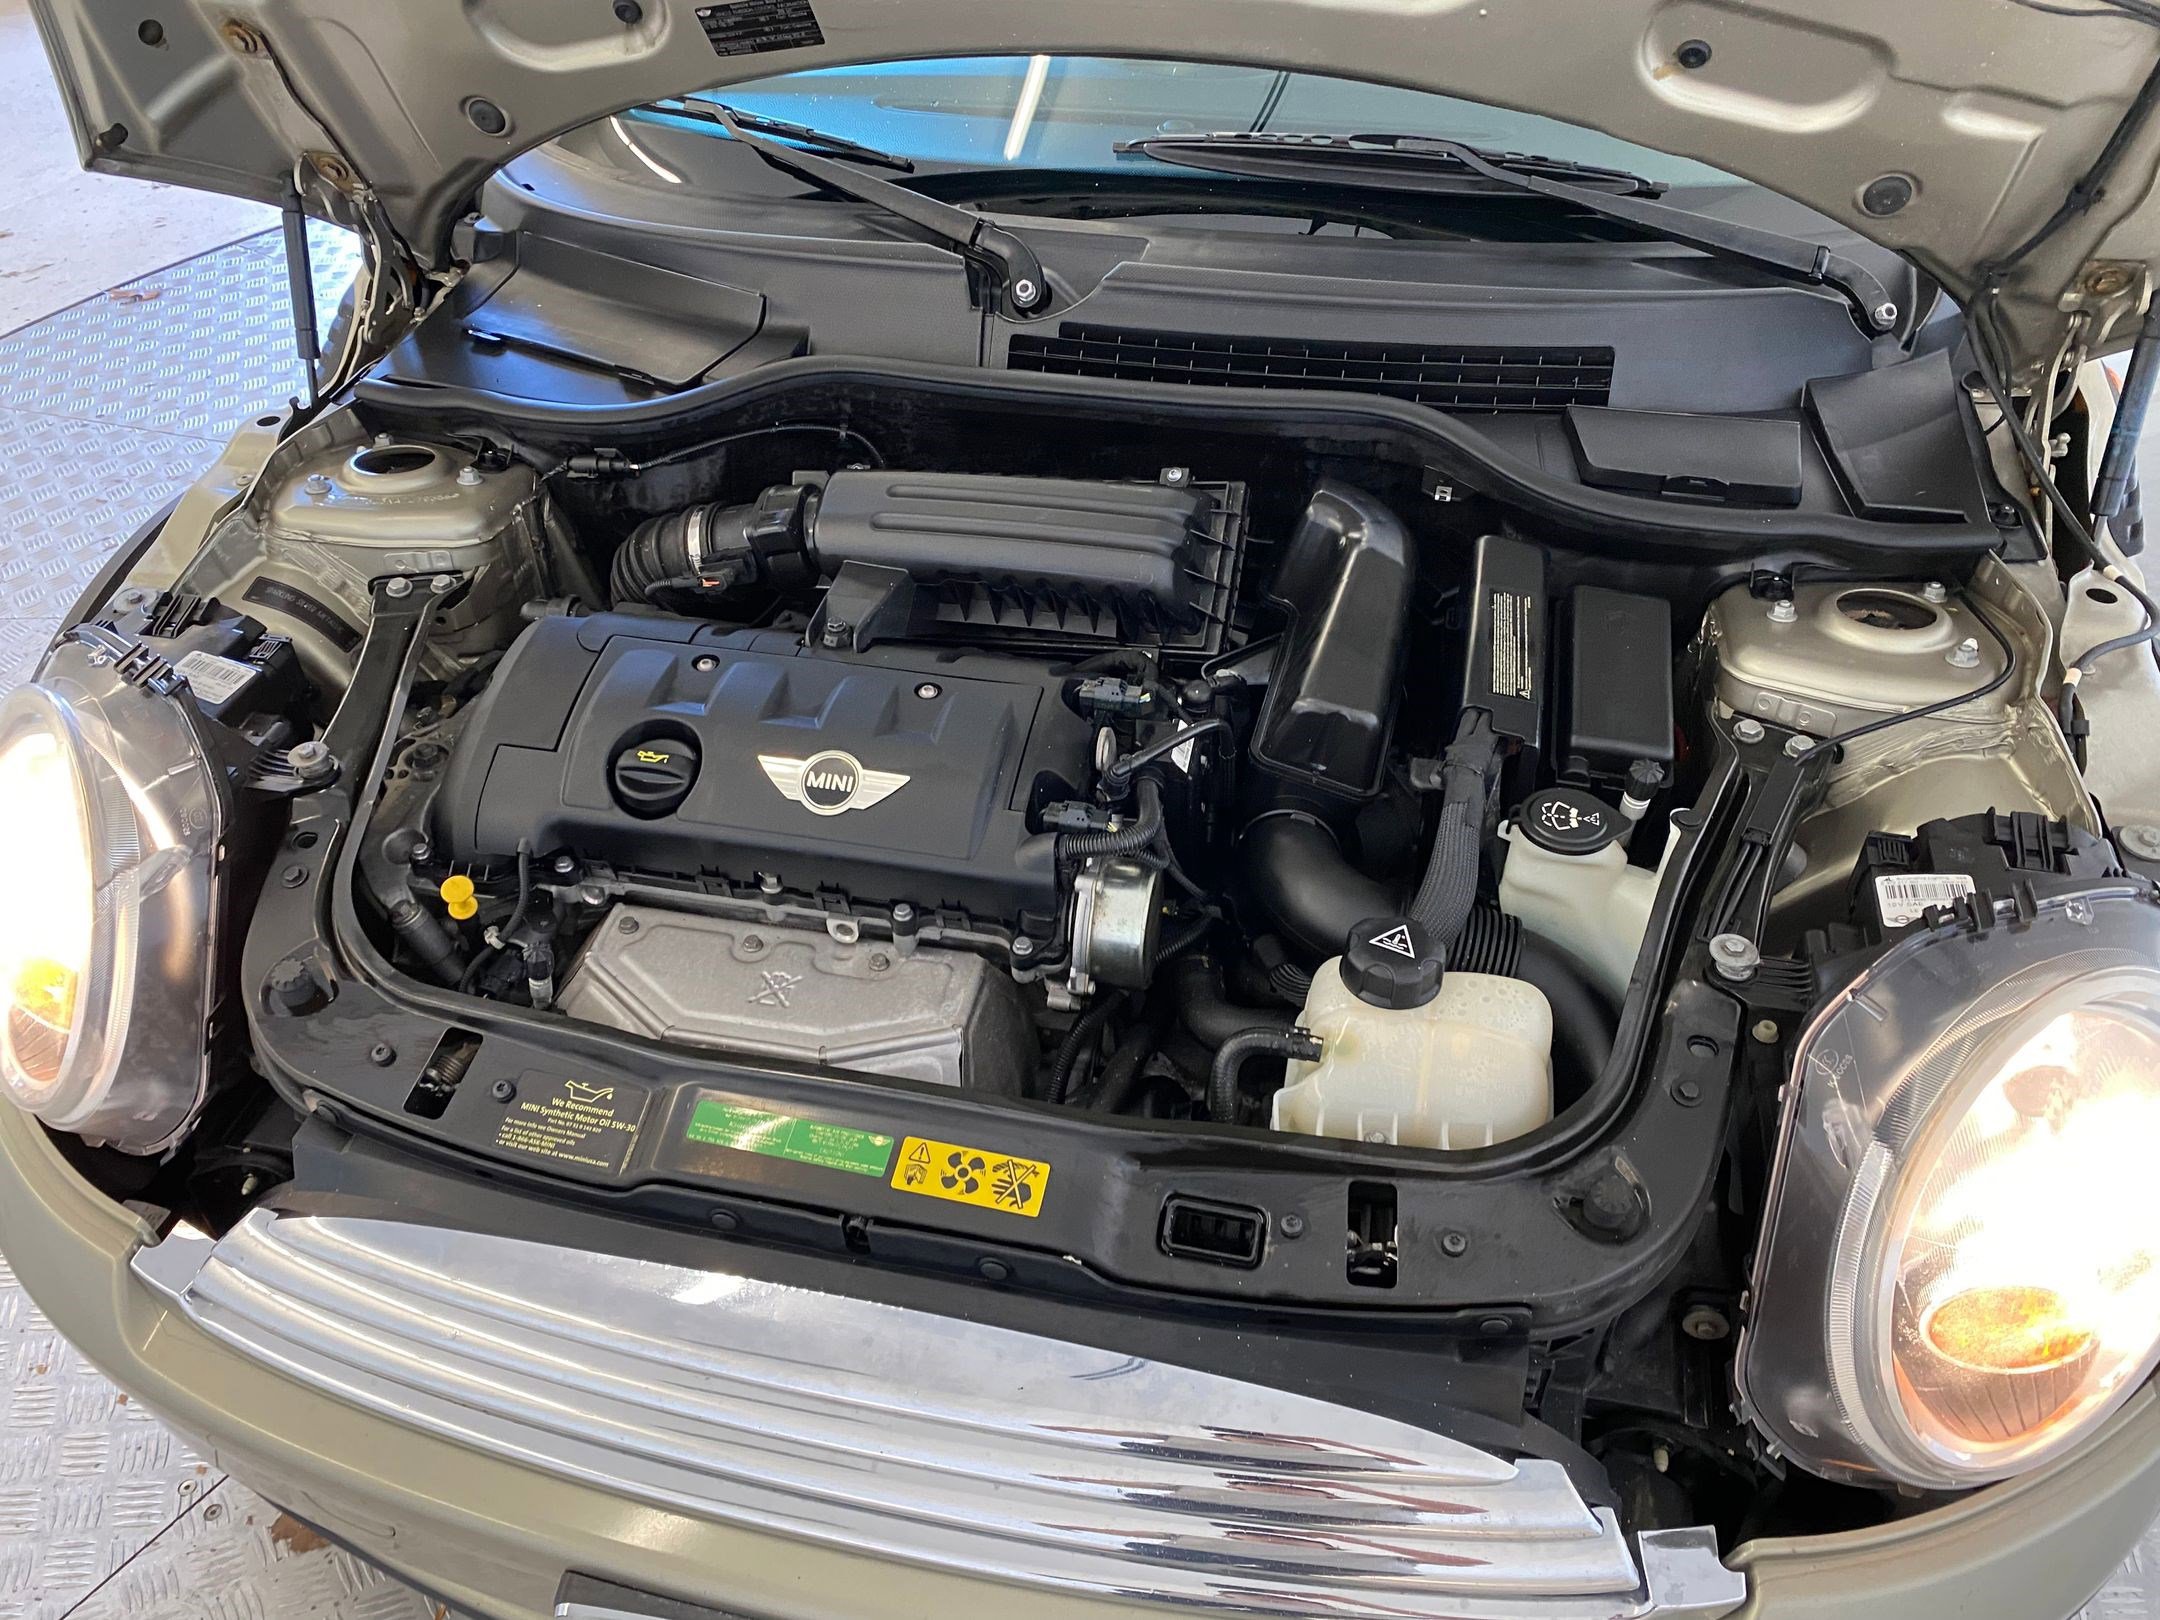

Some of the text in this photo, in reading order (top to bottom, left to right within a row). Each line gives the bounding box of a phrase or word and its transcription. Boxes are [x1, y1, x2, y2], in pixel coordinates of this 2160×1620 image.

[807, 771, 854, 793] MINI
[520, 1101, 636, 1132] MINI Synthetic Motor Oil 5W-30
[551, 1097, 615, 1117] We Recommend
[542, 1134, 566, 1144] approved
[566, 1138, 576, 1146] oils
[566, 1129, 587, 1139] Manual
[505, 1140, 518, 1148] visit
[558, 1152, 609, 1168] www.miniusa.com
